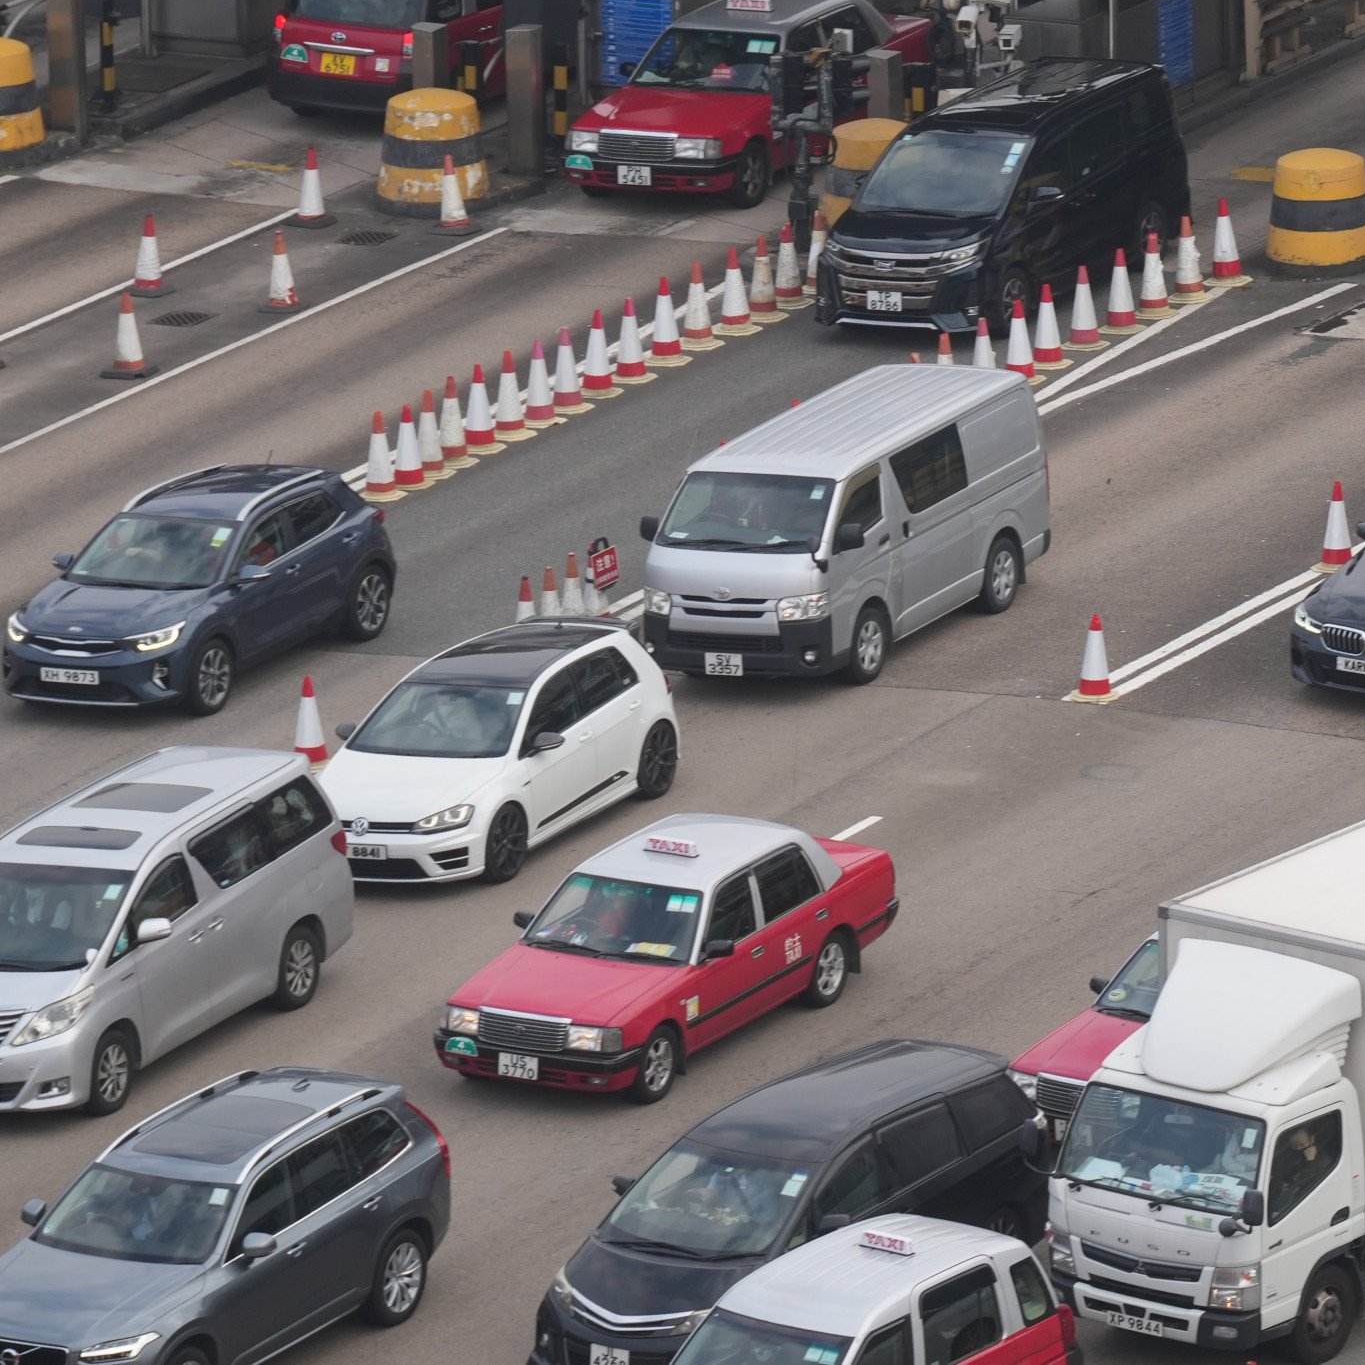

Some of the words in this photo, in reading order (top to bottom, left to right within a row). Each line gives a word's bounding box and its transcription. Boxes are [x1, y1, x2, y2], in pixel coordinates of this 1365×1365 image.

[730, 0, 767, 10] TAXI
[871, 300, 899, 311] 8786
[43, 669, 59, 680] XH
[65, 670, 97, 683] 9873
[708, 663, 741, 675] 3357
[649, 838, 690, 854] TAXI
[510, 1054, 527, 1067] US
[502, 1064, 535, 1079] 3770
[865, 1233, 905, 1251] TAXI
[1108, 1313, 1124, 1325] XP
[1128, 1318, 1160, 1335] 9844
